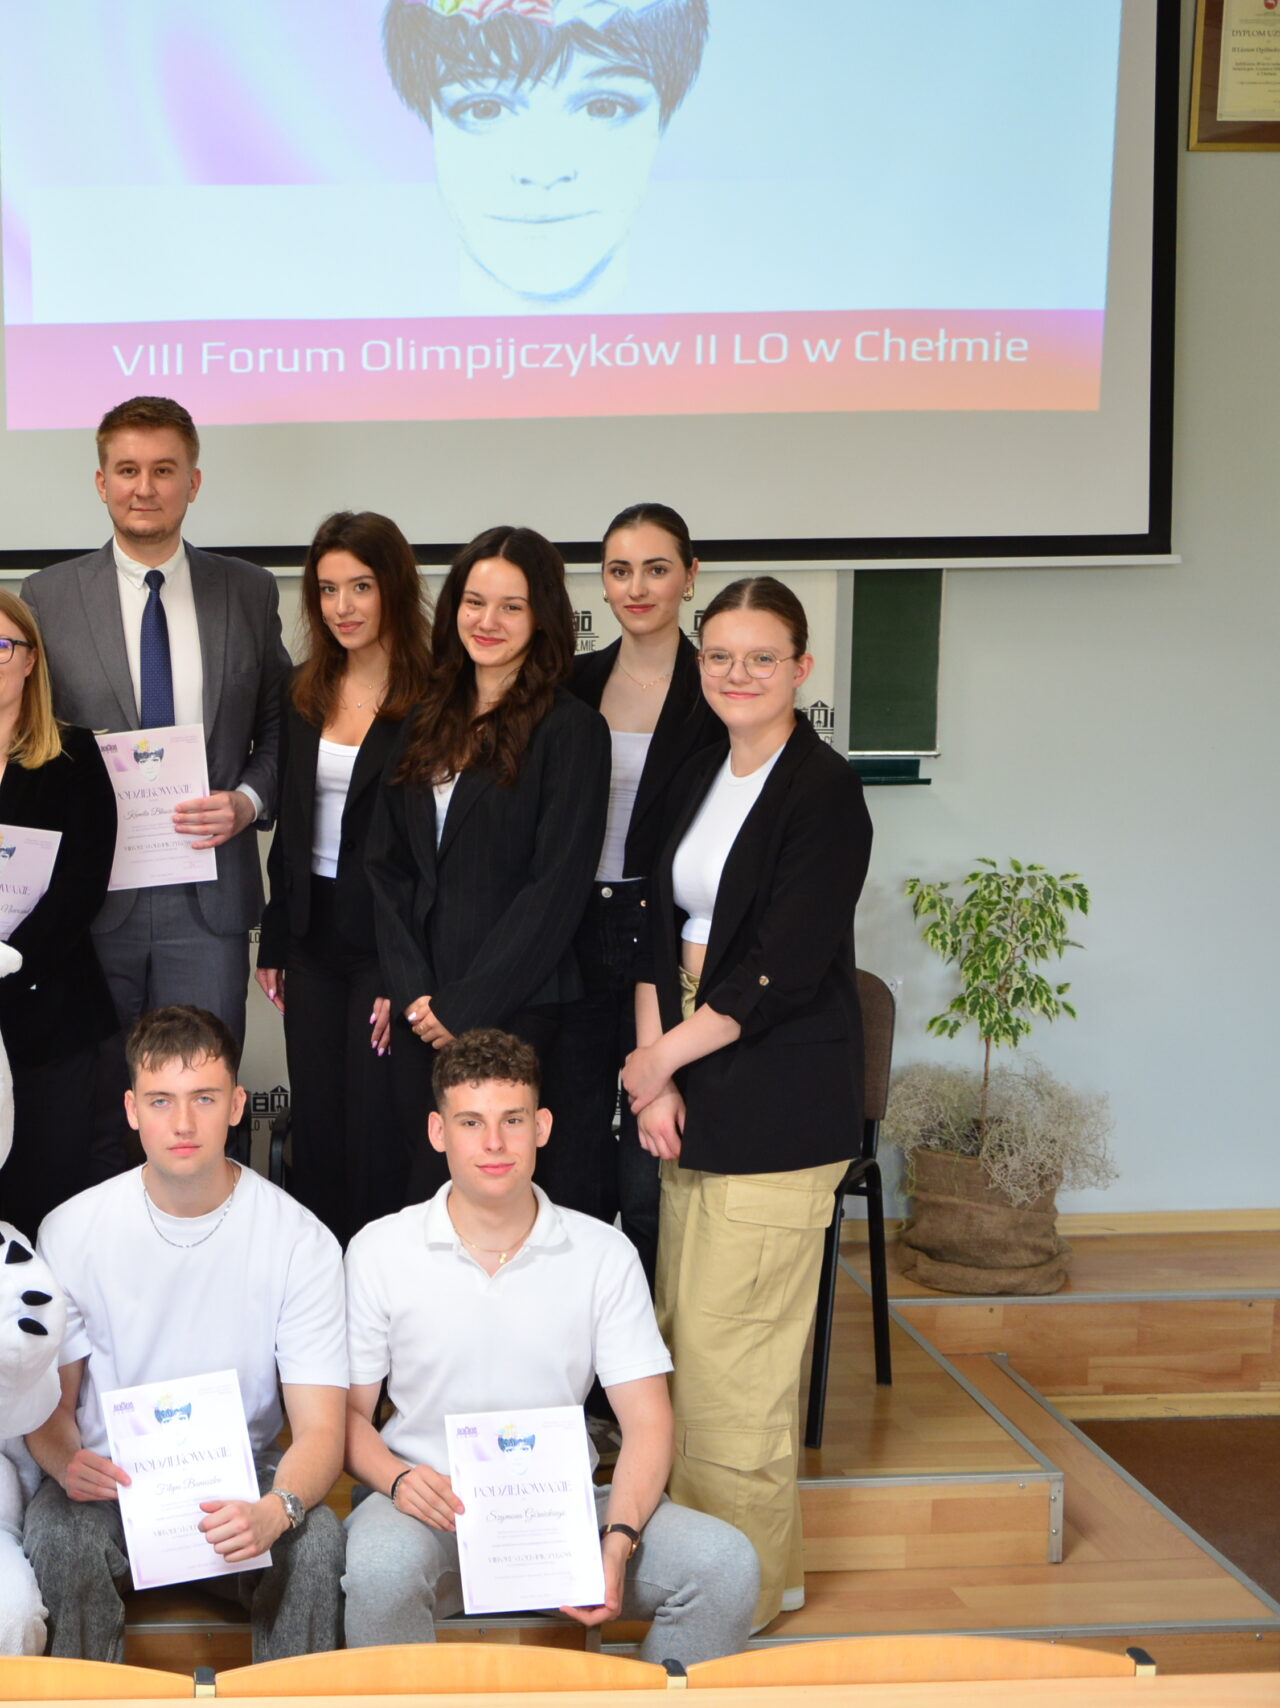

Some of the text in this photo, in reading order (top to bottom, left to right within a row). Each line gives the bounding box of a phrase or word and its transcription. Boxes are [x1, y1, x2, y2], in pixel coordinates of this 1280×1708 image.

[112, 328, 1030, 380] VIII Forum Olimpijczyków II LO w Chełmie
